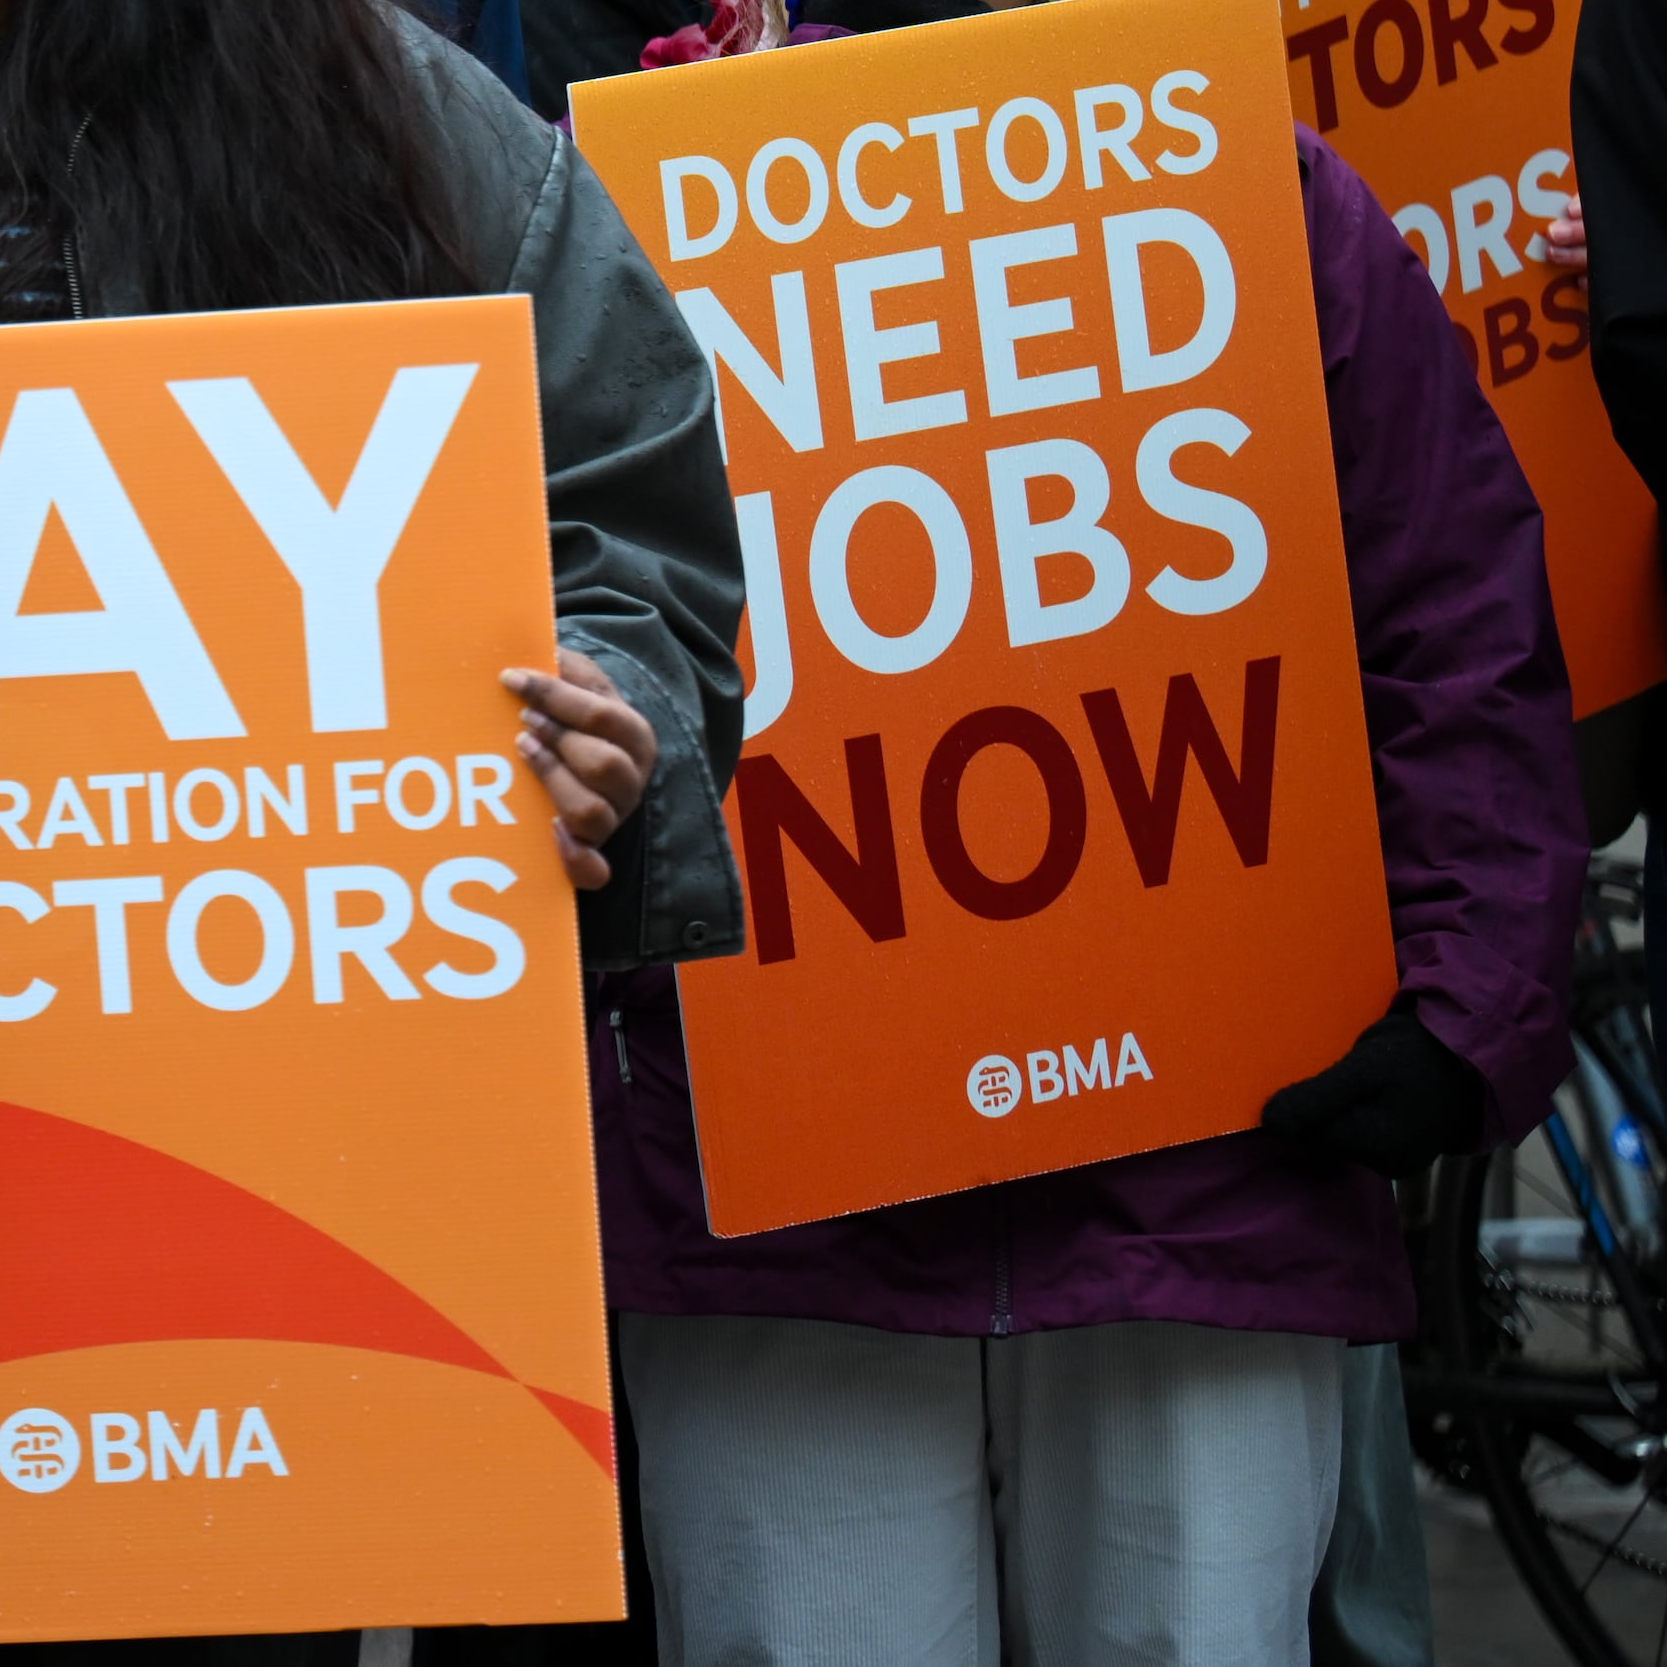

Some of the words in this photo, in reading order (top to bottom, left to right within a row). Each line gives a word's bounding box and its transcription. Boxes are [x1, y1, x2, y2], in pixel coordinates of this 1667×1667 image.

[659, 70, 1218, 262] DOCTORS
[674, 208, 1236, 466] NEED
[734, 408, 1268, 740] JOBS
[334, 754, 516, 833] FOR
[733, 656, 1281, 967] NOW
[1027, 1033, 1153, 1103] BMA
[90, 1406, 290, 1483] BMA
